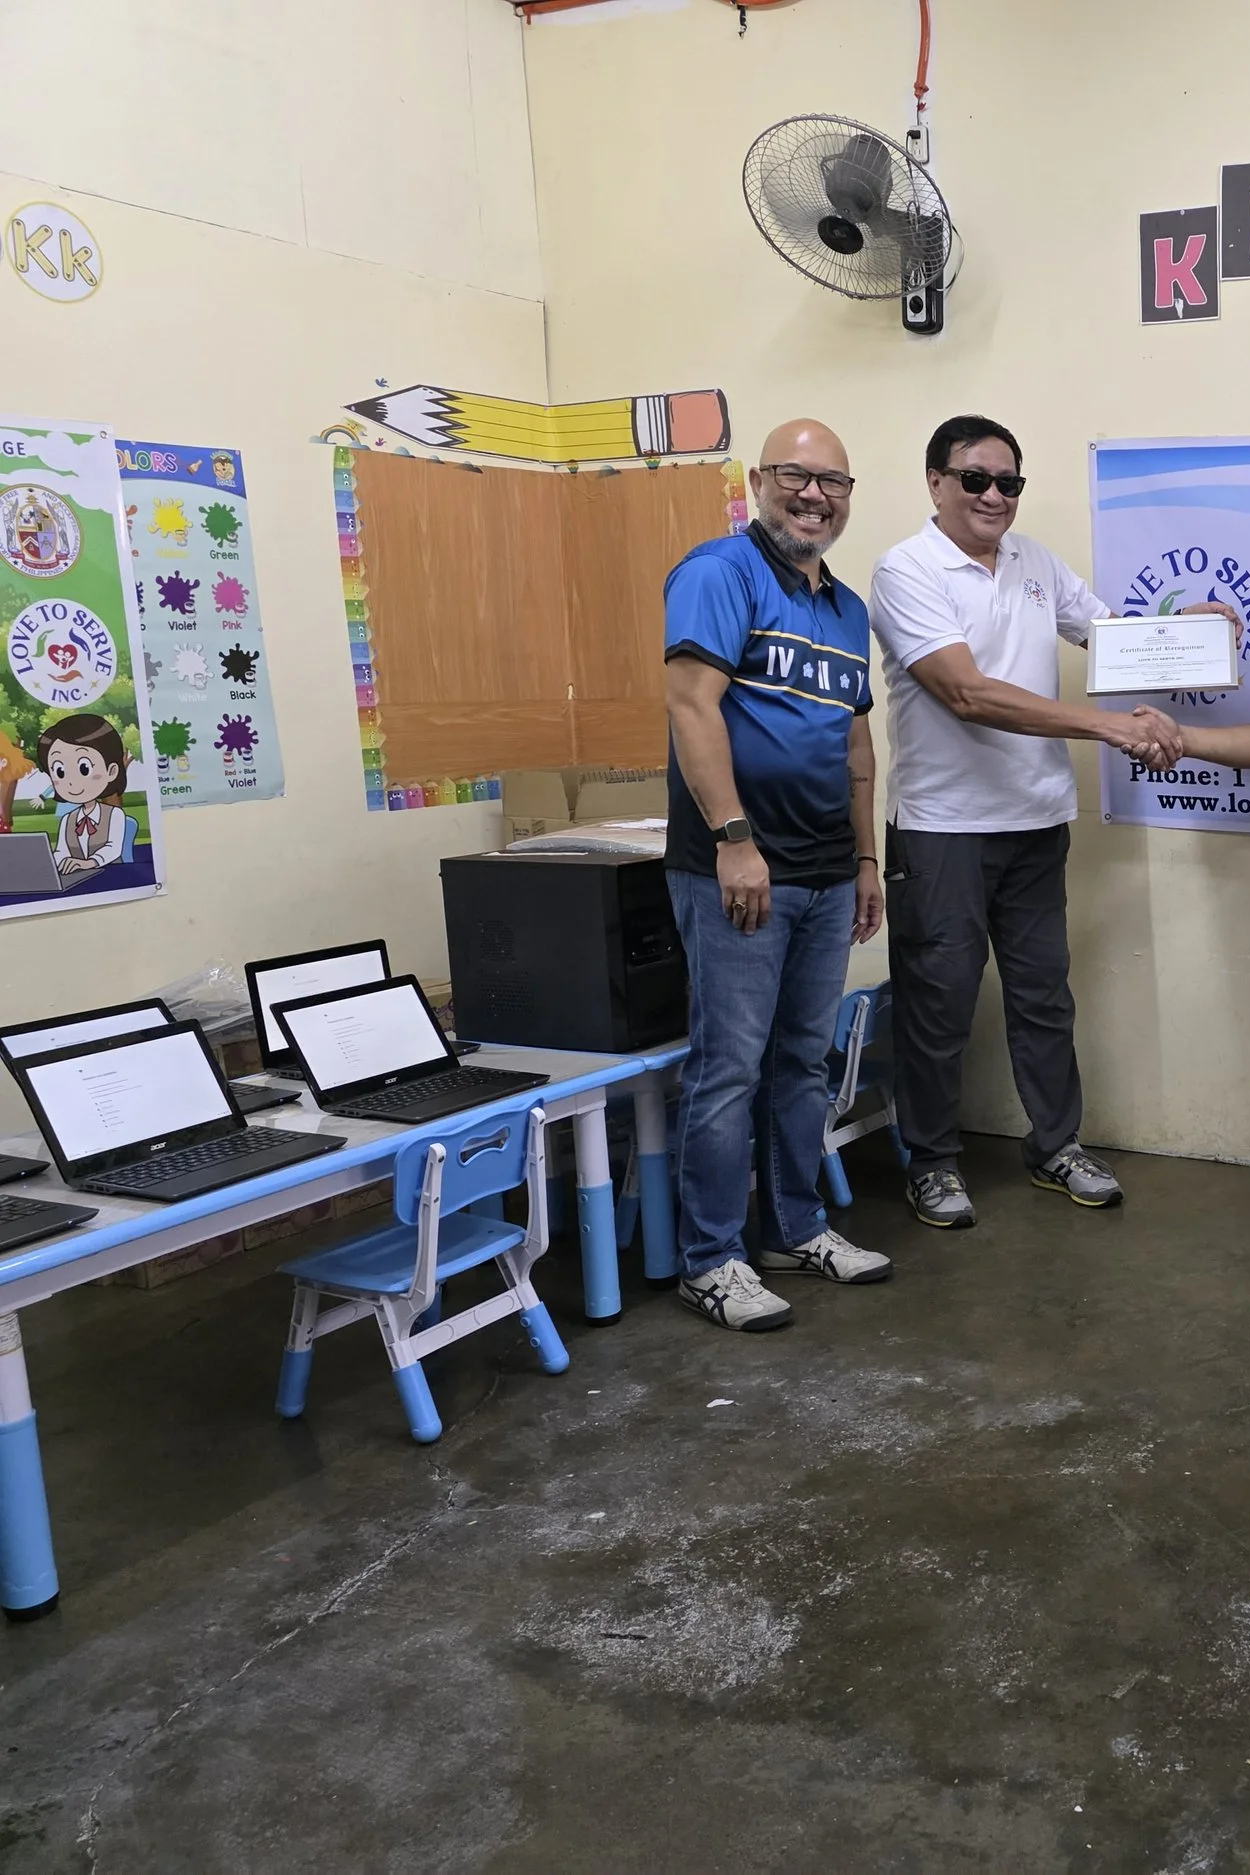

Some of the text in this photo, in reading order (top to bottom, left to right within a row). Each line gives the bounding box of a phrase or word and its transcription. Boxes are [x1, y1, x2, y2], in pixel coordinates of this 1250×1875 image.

[116, 449, 178, 473] OLORS
[41, 492, 58, 502] AND
[210, 550, 239, 560] Green
[1161, 546, 1209, 577] TO
[168, 621, 197, 631] Violet
[222, 620, 243, 630] Pink
[11, 603, 113, 676] LOVE TO SERVE
[51, 688, 88, 703] INC.
[230, 690, 256, 700] Black
[1129, 762, 1220, 786] Phone:
[1232, 768, 1246, 787] 1
[228, 777, 257, 788] Violet
[160, 785, 192, 795] Green
[384, 1076, 398, 1085] acer
[150, 1141, 167, 1151] acer
